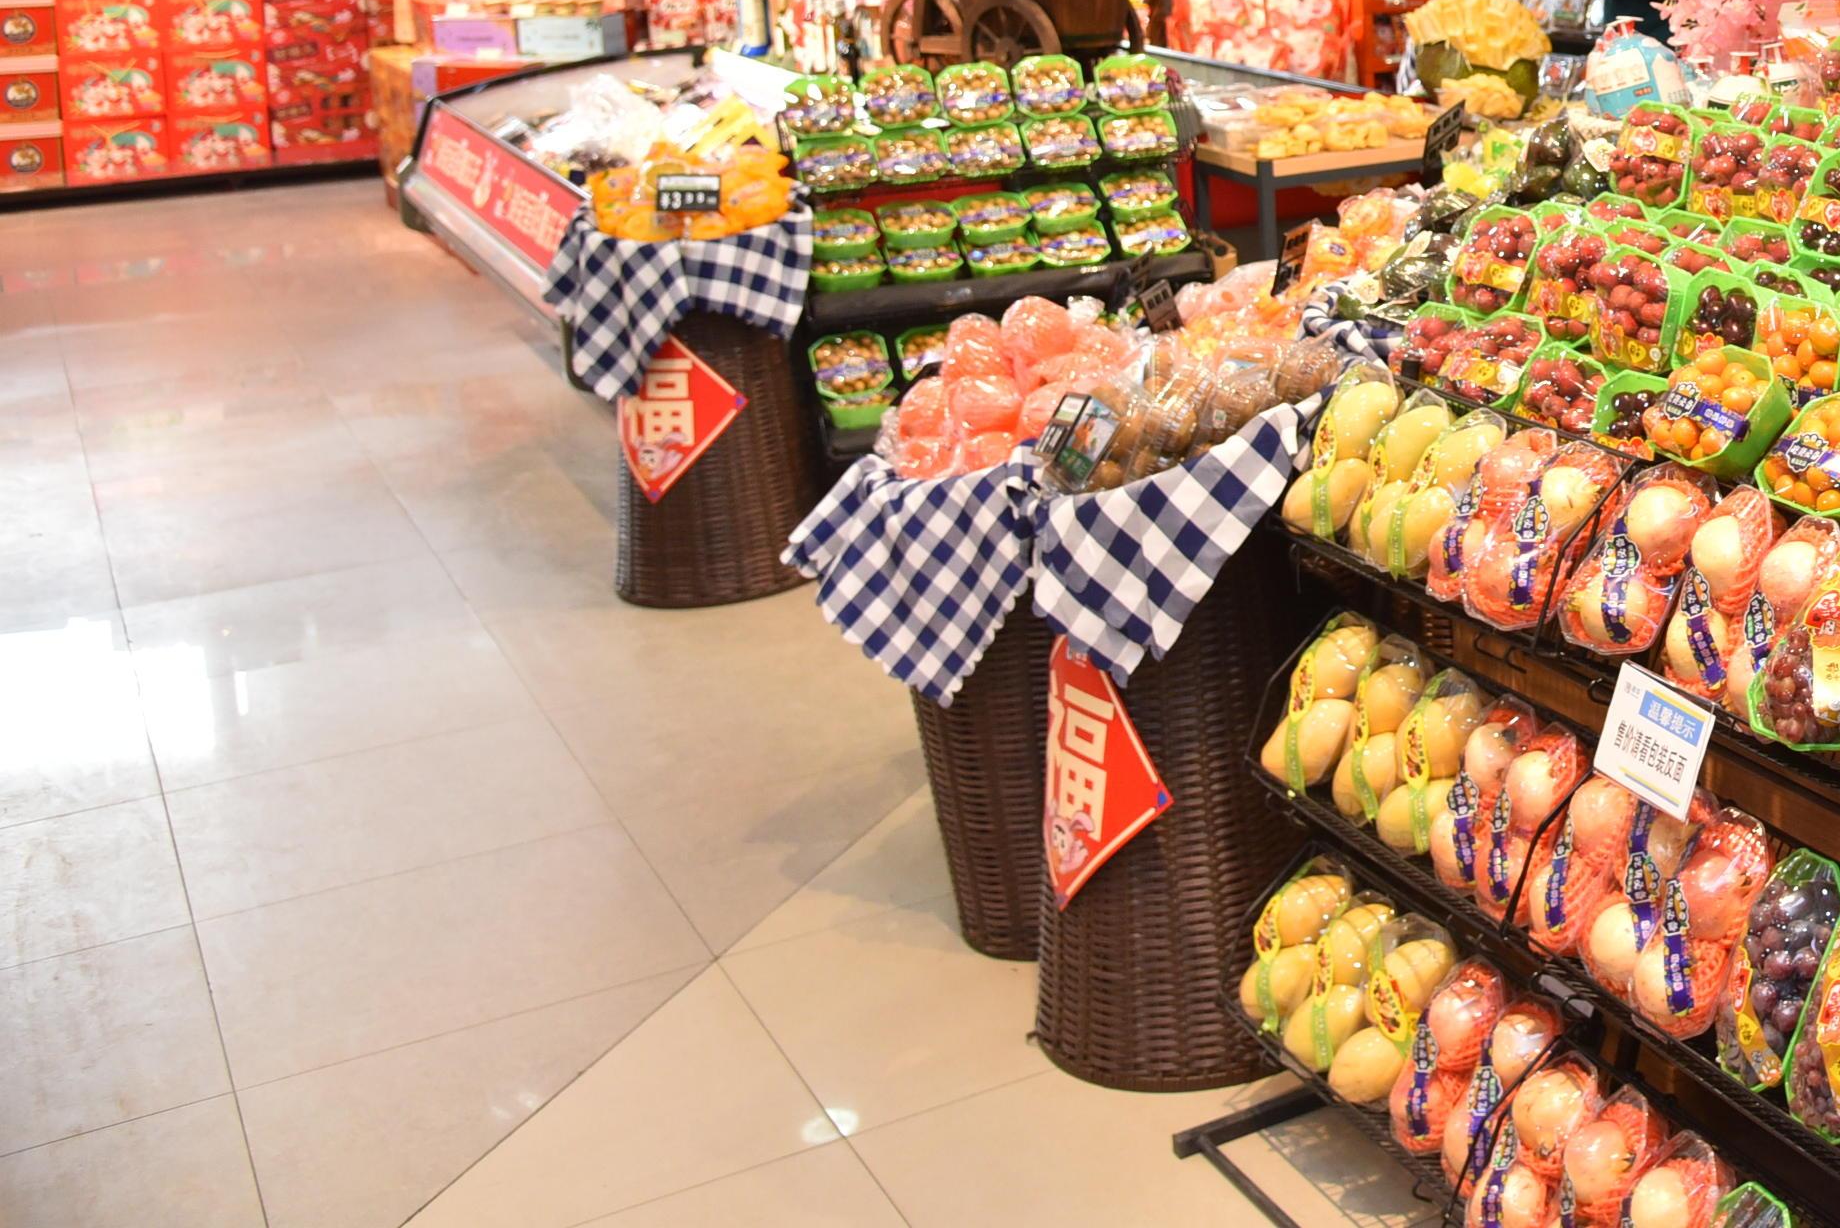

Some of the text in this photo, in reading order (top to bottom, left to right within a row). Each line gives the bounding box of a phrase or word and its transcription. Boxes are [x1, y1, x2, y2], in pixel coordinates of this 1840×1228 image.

[1647, 700, 1696, 740] 温馨提示
[1613, 720, 1688, 784] 售价请看包装反面
